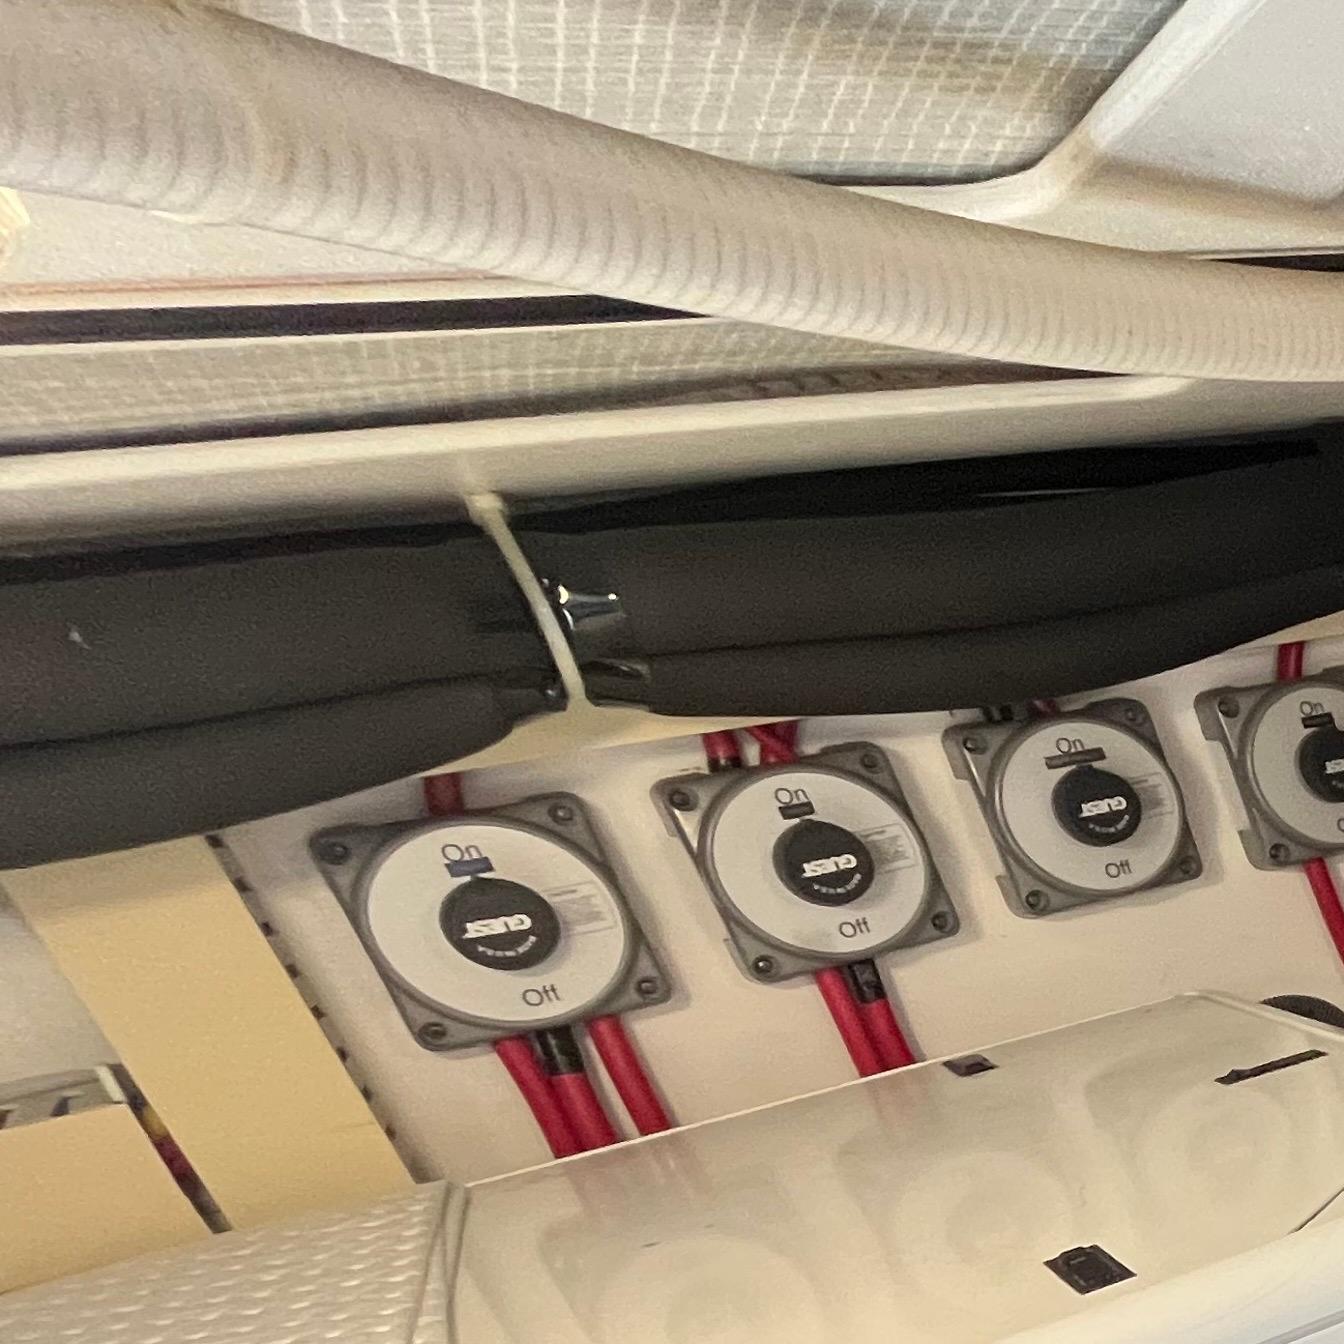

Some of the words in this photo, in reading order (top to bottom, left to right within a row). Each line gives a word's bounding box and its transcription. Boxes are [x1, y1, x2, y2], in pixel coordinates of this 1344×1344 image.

[1300, 701, 1324, 715] On
[1056, 737, 1085, 754] On
[774, 787, 808, 807] On
[442, 843, 482, 864] On
[1105, 860, 1132, 879] Off
[838, 916, 871, 938] Off
[522, 983, 560, 1007] Off
